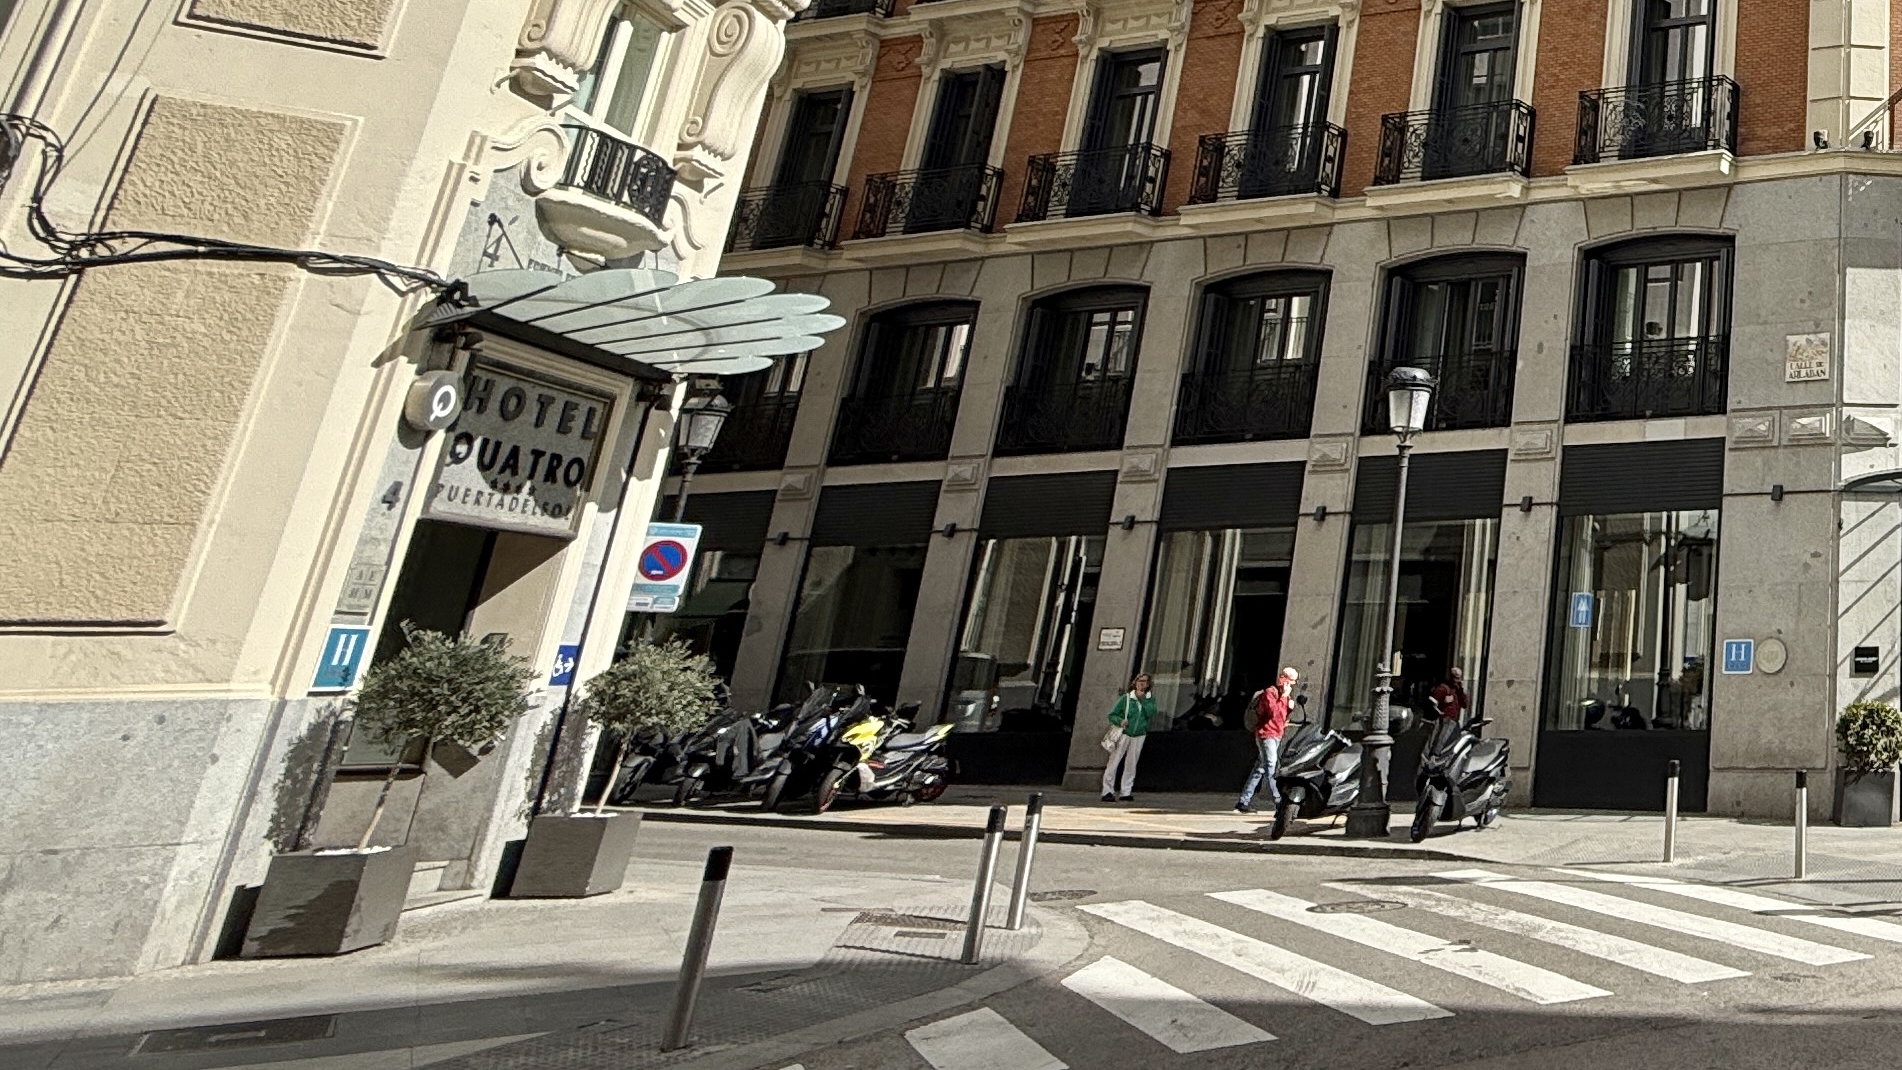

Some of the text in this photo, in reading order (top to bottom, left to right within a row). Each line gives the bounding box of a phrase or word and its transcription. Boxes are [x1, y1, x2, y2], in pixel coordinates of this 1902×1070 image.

[1790, 361, 1814, 370] CALLE
[463, 375, 598, 440] HOTEL
[443, 432, 585, 487] QUATRO
[381, 480, 404, 512] 4
[331, 633, 359, 666] H
[1730, 643, 1747, 662] H
